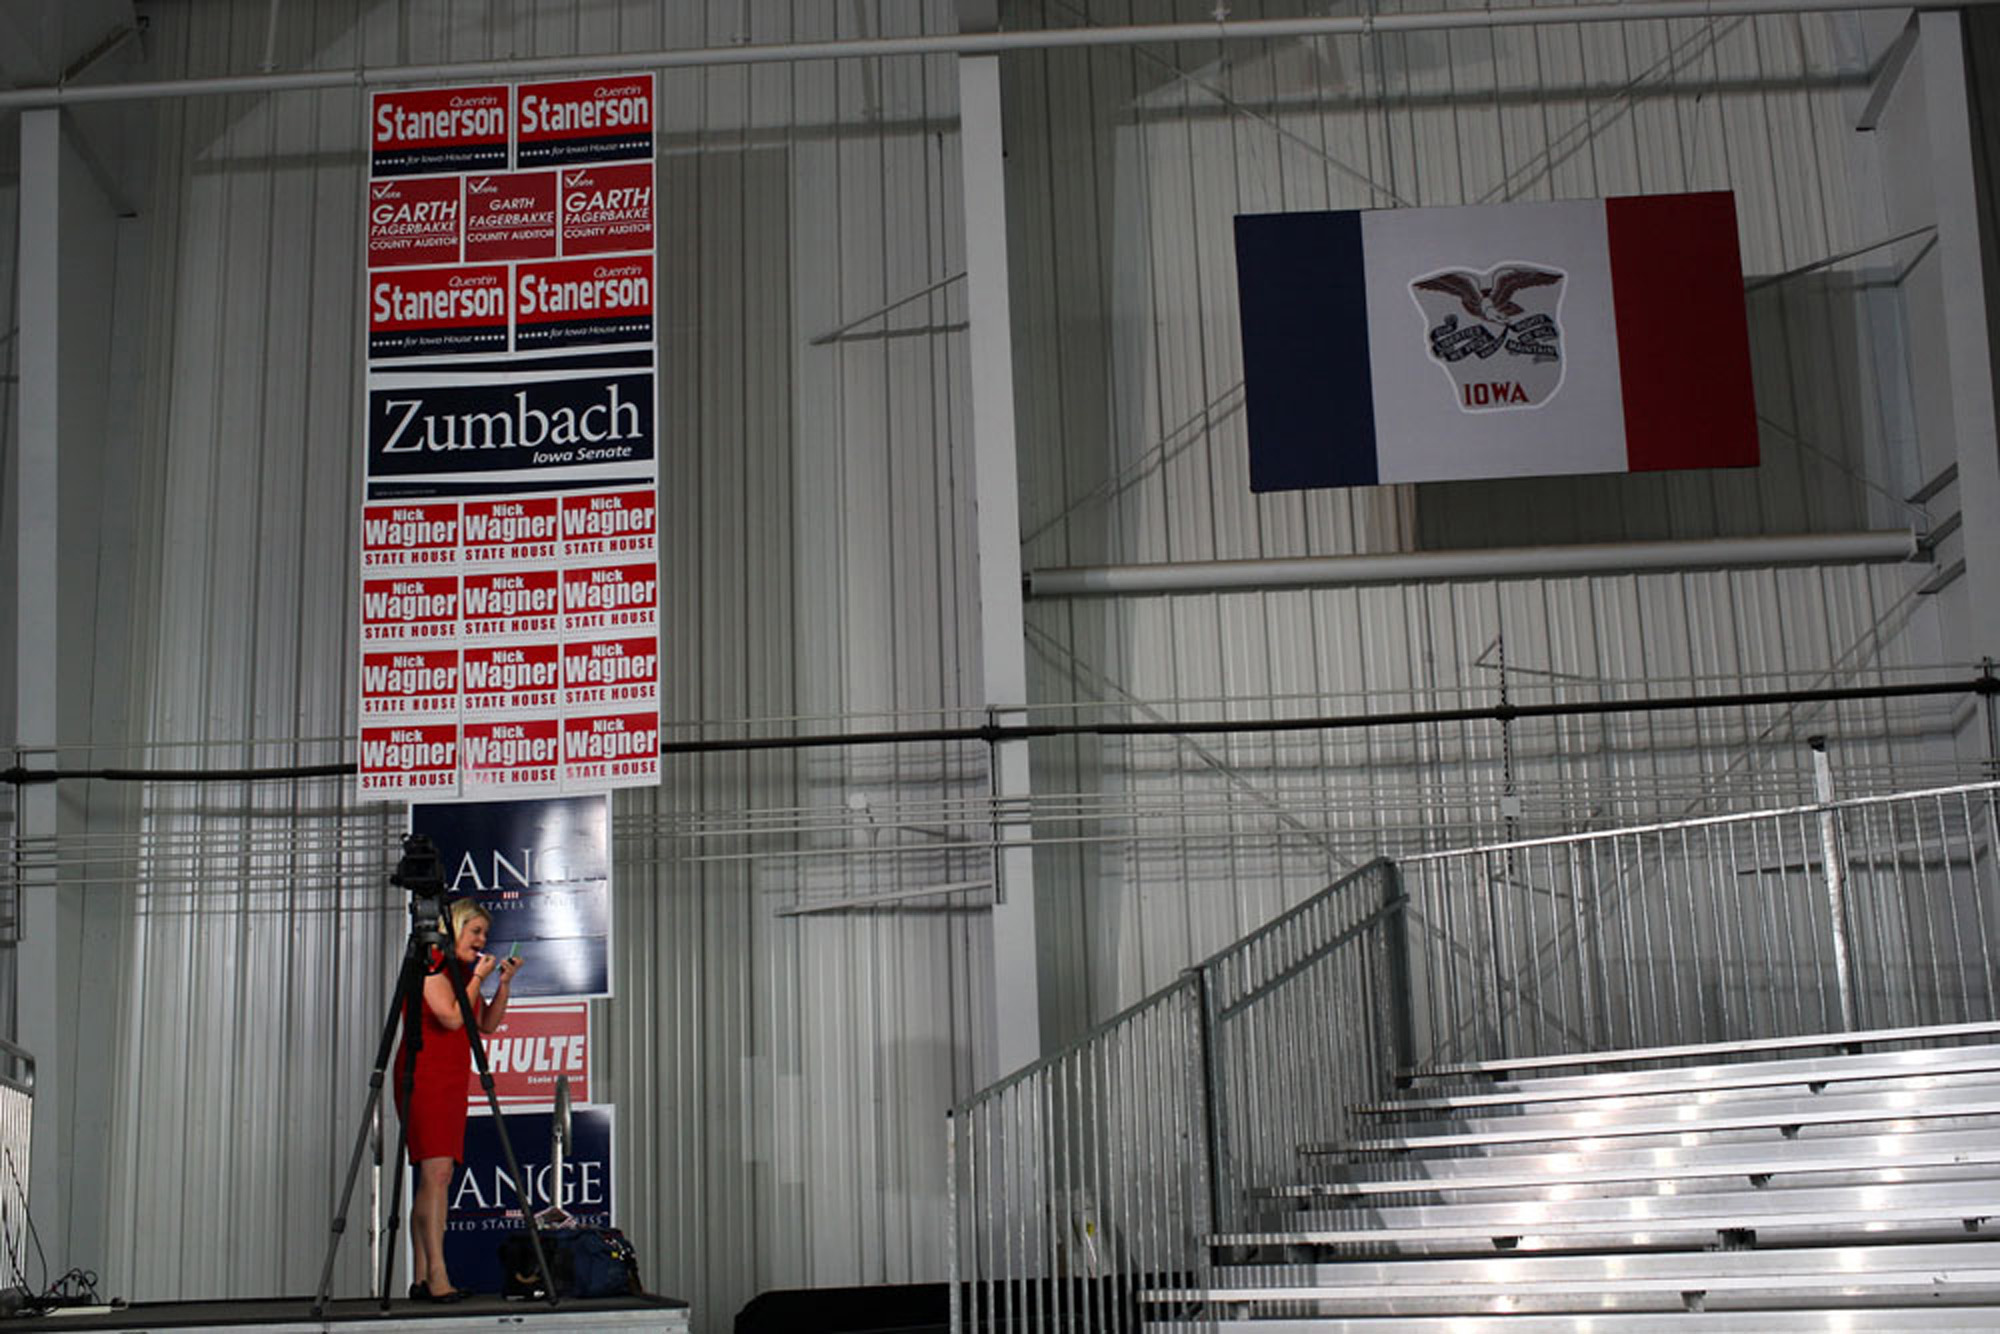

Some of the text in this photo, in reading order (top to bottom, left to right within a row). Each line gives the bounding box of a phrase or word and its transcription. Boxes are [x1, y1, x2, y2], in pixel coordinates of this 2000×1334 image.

[594, 86, 642, 98] Quentin
[449, 96, 498, 107] Quentin
[521, 95, 648, 133] Stanerson
[377, 103, 504, 142] Stanerson
[489, 198, 535, 212] GARTH
[565, 187, 650, 212] GARTH
[372, 200, 458, 224] GARTH
[468, 212, 555, 227] FAGERBAKKE
[565, 208, 649, 224] FAGERBAKKE
[371, 221, 456, 236] FAGERBAKKE
[467, 229, 555, 243] COUNTY AUDITOR
[564, 224, 651, 239] COUNTY AUDITOR
[370, 236, 459, 250] COUNTY AUDITOR
[594, 266, 642, 278] Quentin
[448, 276, 497, 288] Quentin
[520, 274, 649, 314] Stanerson
[374, 283, 504, 322] Stanerson
[1463, 382, 1530, 406] IOWA
[381, 384, 643, 454] Zumbach
[533, 445, 632, 464] Iowa Senate
[493, 504, 523, 517] Nick
[591, 497, 621, 510] Nick
[393, 509, 424, 521] Nick
[564, 507, 654, 535] Wagner
[365, 519, 456, 547] Wagner
[465, 514, 555, 541] Wagner
[465, 544, 555, 560] STATE HOUSE
[564, 537, 653, 555] STATE HOUSE
[365, 550, 455, 565] STATE HOUSE
[493, 577, 523, 590] Nick
[592, 569, 622, 583] Nick
[393, 582, 423, 595] Nick
[565, 580, 655, 609] Wagner
[365, 592, 456, 620] Wagner
[465, 587, 556, 615] Wagner
[465, 618, 555, 634] STATE HOUSE
[566, 611, 655, 629] STATE HOUSE
[365, 624, 455, 639] STATE HOUSE
[493, 651, 524, 664] Nick
[592, 643, 623, 657] Nick
[393, 655, 424, 668] Nick
[565, 654, 655, 683] Wagner
[364, 666, 456, 694] Wagner
[465, 660, 557, 689] Wagner
[465, 693, 556, 709] STATE HOUSE
[566, 685, 655, 703] STATE HOUSE
[364, 698, 455, 712] STATE HOUSE
[493, 726, 525, 739] Nick
[593, 718, 624, 732] Nick
[391, 730, 422, 743] Nick
[566, 729, 656, 758] Wagner
[362, 740, 456, 769] Wagner
[465, 736, 557, 765] Wagner
[512, 768, 555, 782] HOUSE
[566, 760, 656, 779] STATE HOUSE
[362, 773, 454, 788] STATE HOUSE
[471, 1035, 585, 1074] HULTE
[450, 1161, 603, 1210] ANGE
